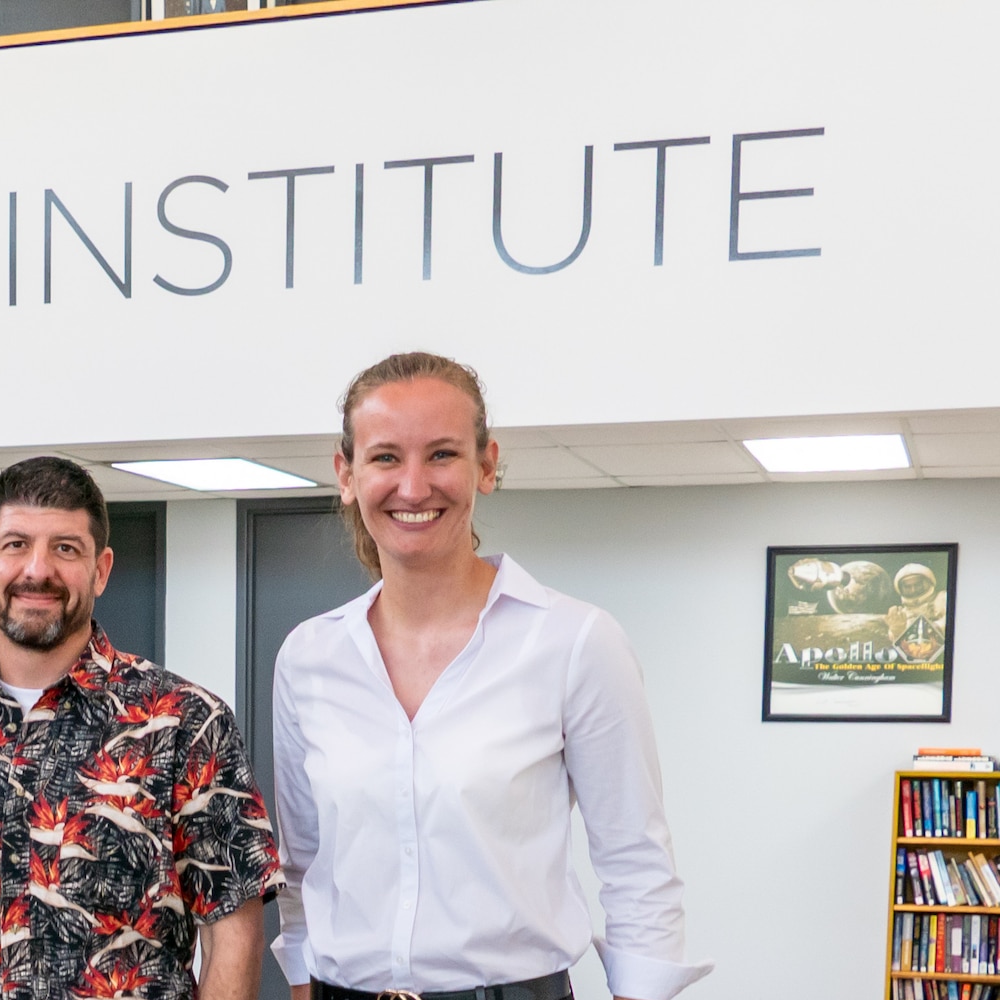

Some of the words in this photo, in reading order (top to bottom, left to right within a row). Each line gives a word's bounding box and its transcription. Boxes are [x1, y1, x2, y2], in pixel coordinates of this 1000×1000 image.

[9, 127, 826, 306] INSTITUTE
[773, 640, 898, 670] Apollo
[814, 663, 830, 671] The
[832, 663, 863, 671] Golden
[864, 663, 881, 672] Age
